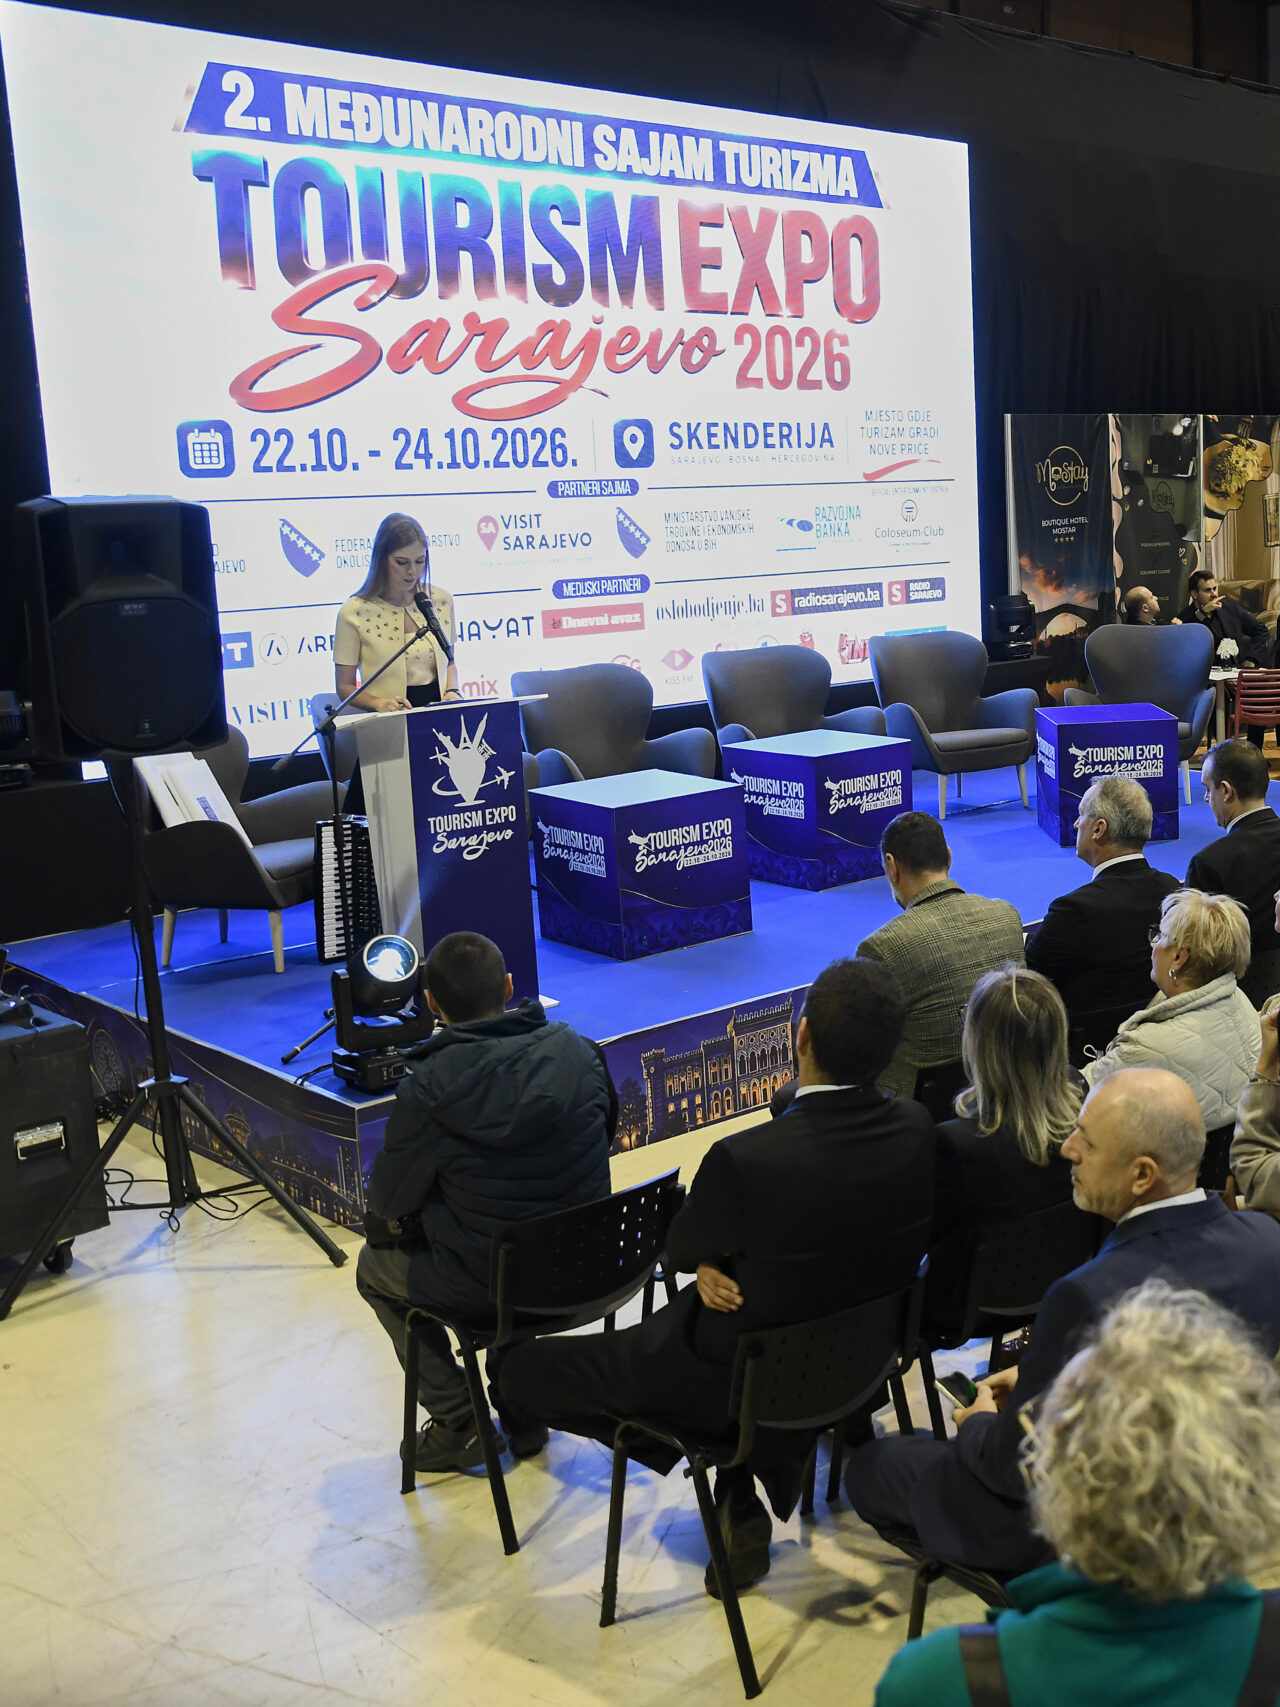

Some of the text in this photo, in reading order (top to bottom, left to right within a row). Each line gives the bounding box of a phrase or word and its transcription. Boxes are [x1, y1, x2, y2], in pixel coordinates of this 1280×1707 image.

[222, 70, 859, 198] 2. MEĐUNARODNI SAJAM TURIZMA
[190, 148, 880, 324] TOURISM EXPO
[228, 262, 852, 420] Sarajevo 2026
[865, 410, 932, 421] MJESTO GDJE
[668, 421, 835, 450] SKENDERIJA
[860, 427, 939, 438] TURIZAM GRADI
[250, 428, 359, 473] 22.10.
[393, 427, 578, 470] 24.10.2026.
[869, 443, 897, 455] NOVE
[558, 480, 632, 496] PARTNERI SAJMA
[501, 514, 542, 530] VISIT
[664, 511, 718, 523] MINISTARSTVO
[815, 505, 862, 521] RAZVOJNA
[1041, 516, 1089, 527] BOUTIQUE HOTEL
[479, 521, 497, 534] SA
[665, 525, 700, 538] TRGOVINE
[708, 523, 754, 536] EKONOMSKIH
[816, 522, 851, 539] BANKA
[1052, 526, 1076, 535] MOSTAR
[335, 538, 374, 552] FEDERA
[503, 532, 592, 551] SARAJEVO
[666, 539, 695, 552] ODNOSA
[214, 560, 246, 573] AJEVO
[601, 578, 642, 594] PARTNERI
[891, 581, 930, 602] S RADIO
[909, 589, 942, 601] SARAJEVO
[656, 593, 765, 622] oslobodjenje.ba
[775, 588, 880, 614] S radiosarajevo.ba
[562, 613, 641, 629] Dnevni avaz
[232, 700, 292, 725] VISIT
[1086, 744, 1164, 762] TOURISM EXPO
[1073, 761, 1141, 778] Sarajevo
[743, 775, 804, 798] TOURISM EXPO
[839, 769, 902, 796] TOURISM EXPO
[744, 794, 787, 815] arajevo
[829, 791, 884, 814] Sarajevo
[428, 805, 516, 834] TOURISM EXPO
[550, 825, 605, 854] TOURISM EXPO
[649, 817, 732, 851] TOURISM EXPO
[432, 829, 514, 860] Sarajevo
[543, 838, 590, 871] Sarajevo
[635, 844, 709, 872] Sarajevo
